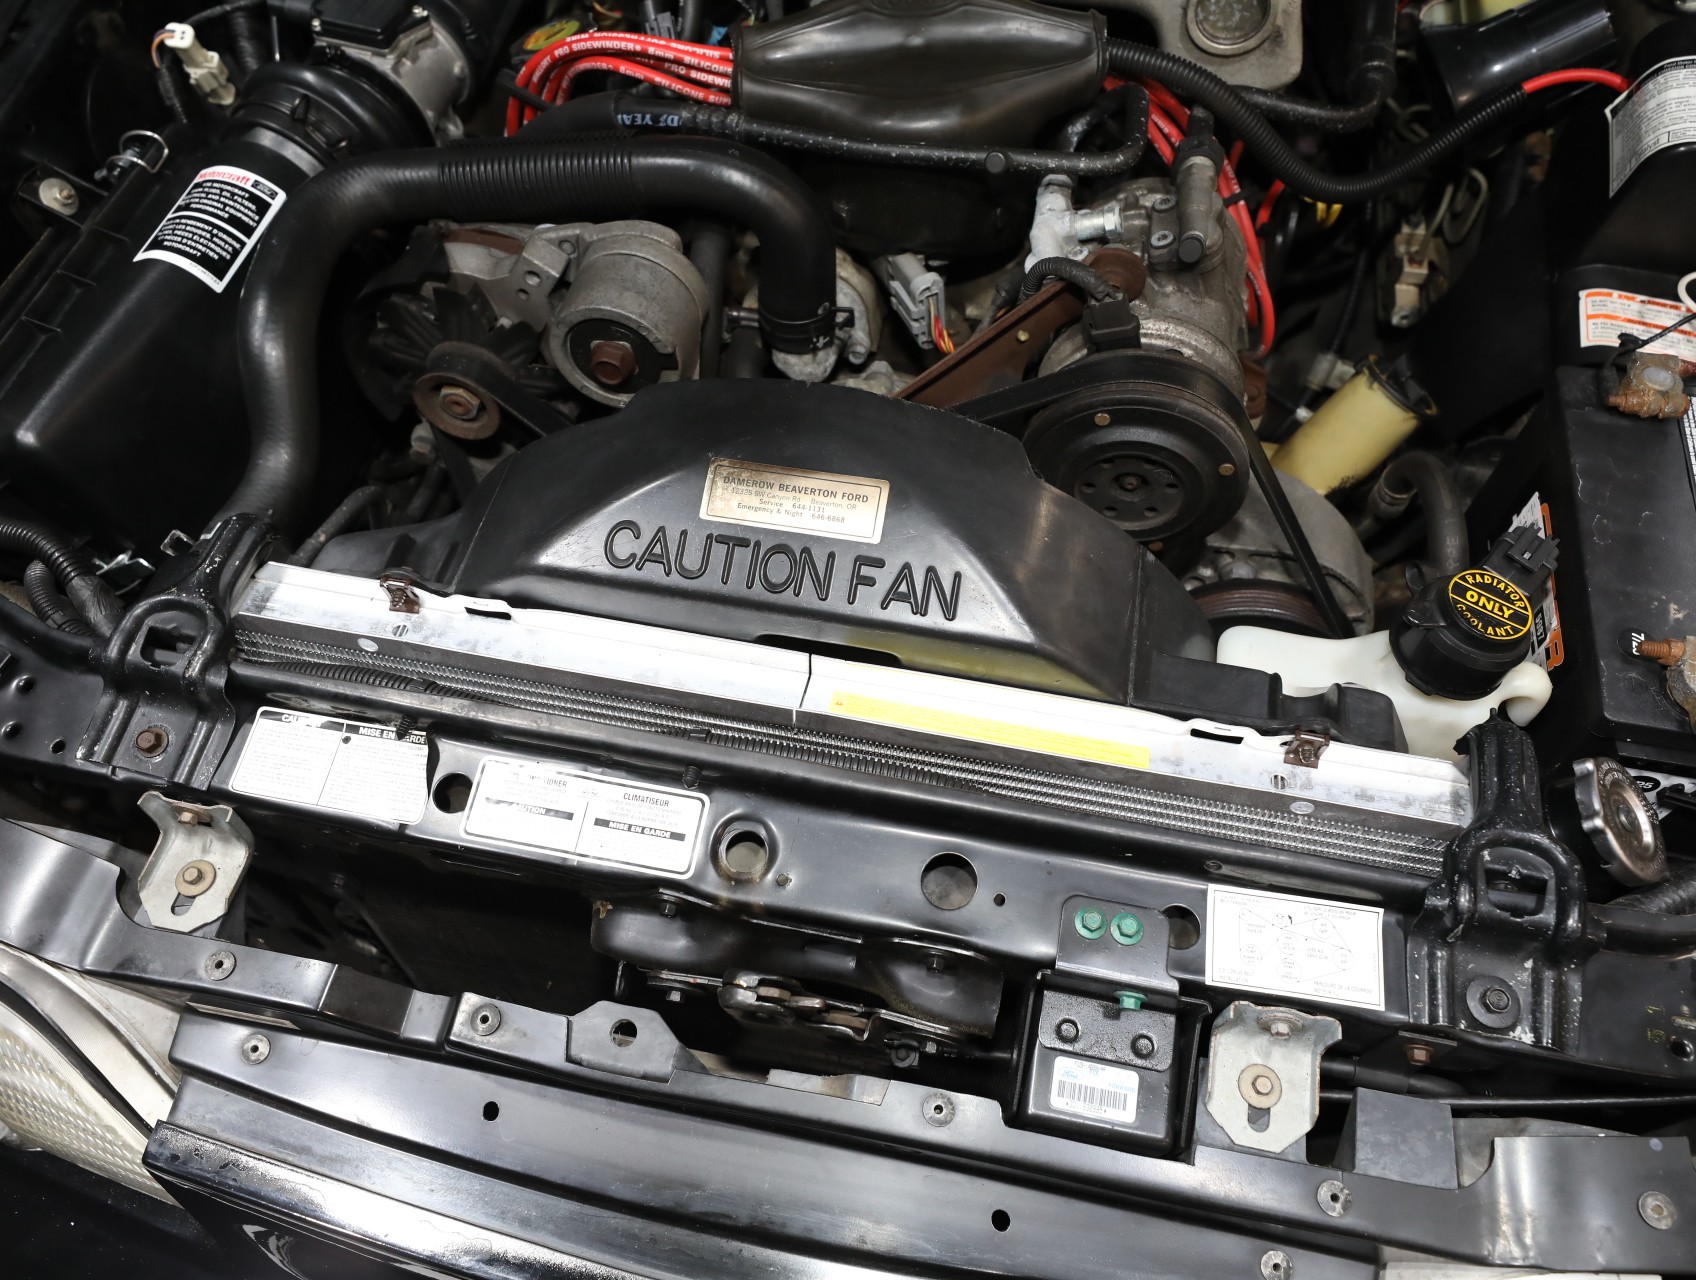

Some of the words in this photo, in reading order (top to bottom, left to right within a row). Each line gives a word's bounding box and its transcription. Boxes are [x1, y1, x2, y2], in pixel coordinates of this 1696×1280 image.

[554, 46, 570, 58] PRO
[648, 47, 674, 60] 8mm
[724, 476, 774, 490] DAMEROW
[778, 483, 838, 499] BEAVERTON
[842, 492, 869, 503] FORD
[754, 489, 765, 498] SW
[766, 492, 790, 502] Canyon
[737, 502, 774, 514] Emergency
[784, 508, 803, 518] Night
[812, 513, 846, 524] 646-6868
[759, 498, 784, 508] Service
[792, 502, 825, 514] 644-1131
[604, 520, 836, 601] CAUTION
[847, 554, 962, 621] FAN
[1465, 574, 1525, 608] RADIATOR
[1466, 590, 1514, 618] ONLY
[1456, 604, 1514, 636] COOLANT
[358, 726, 382, 738] MISE
[382, 730, 396, 740] EN
[403, 734, 426, 744] ARDE
[624, 792, 670, 807] CLIMATISEUR
[515, 804, 546, 815] AUTION
[608, 821, 630, 831] MISE
[631, 824, 643, 833] EN
[644, 828, 672, 838] GARDE
